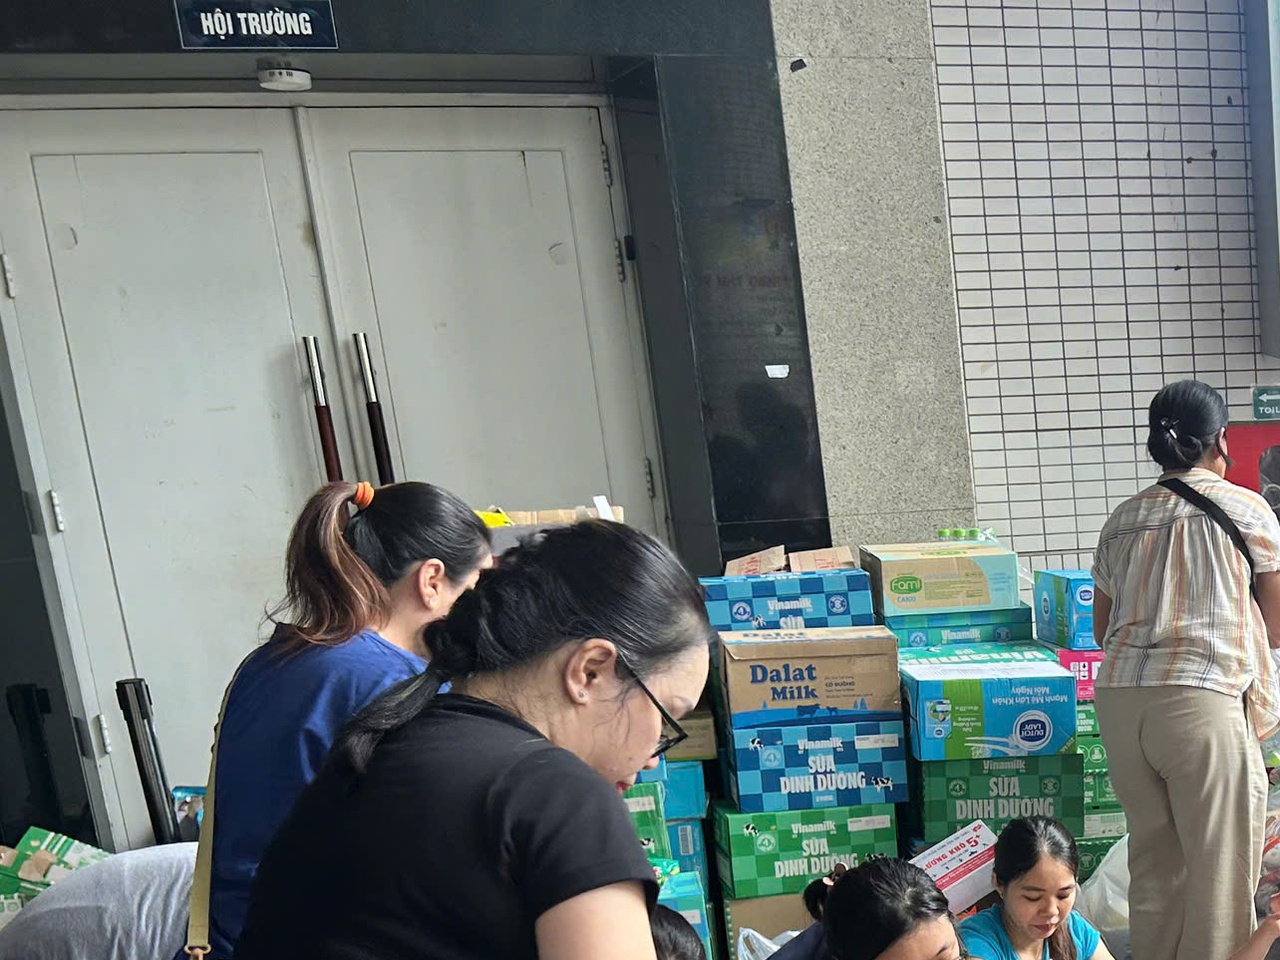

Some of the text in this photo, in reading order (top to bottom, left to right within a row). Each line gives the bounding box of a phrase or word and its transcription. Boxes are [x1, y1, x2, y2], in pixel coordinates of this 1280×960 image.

[200, 7, 312, 39] HỘI TRƯỜNG
[890, 577, 921, 591] Fami
[767, 598, 813, 612] Vinamilk
[750, 663, 817, 684] Dalat
[771, 686, 819, 701] Milk
[1020, 728, 1046, 738] DUTCH
[1023, 723, 1043, 731] LADY
[797, 737, 843, 751] Vinamilk
[983, 760, 1026, 772] Vinamilk
[780, 775, 815, 794] DINH
[956, 799, 995, 819] DINH
[791, 820, 836, 835] Vinamilk
[774, 859, 809, 878] DINH
